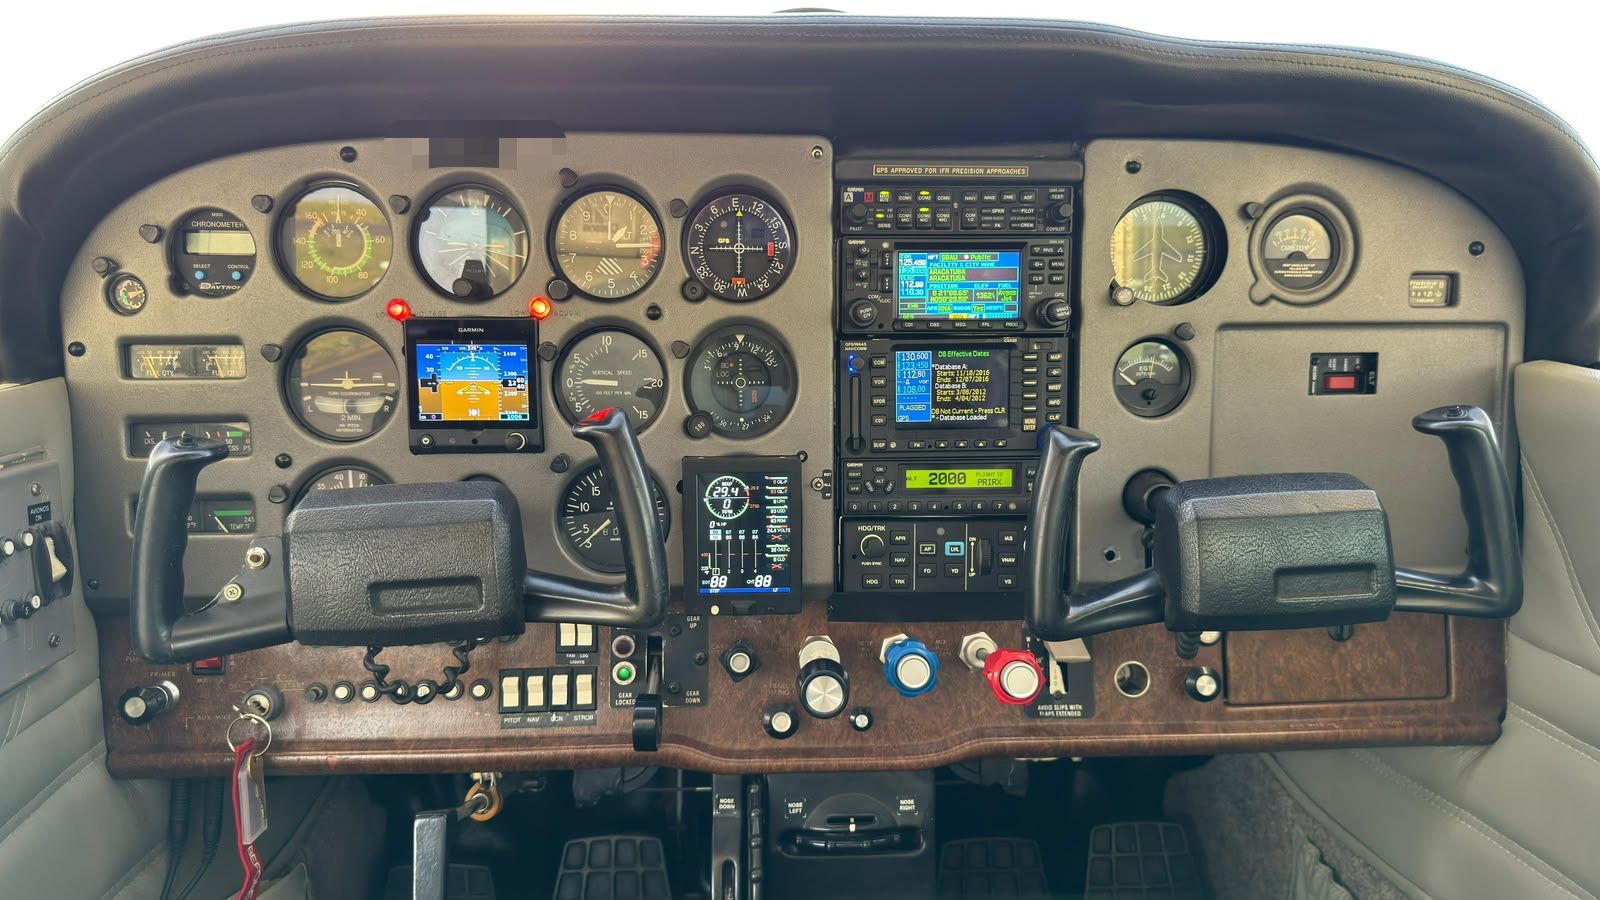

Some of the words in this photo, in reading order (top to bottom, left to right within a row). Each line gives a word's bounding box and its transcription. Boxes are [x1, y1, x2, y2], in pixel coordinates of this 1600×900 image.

[731, 197, 739, 207] E
[752, 201, 764, 213] 12
[356, 208, 366, 216] 40
[710, 205, 718, 214] 6
[305, 211, 318, 219] 160
[582, 211, 591, 221] 9
[695, 223, 703, 232] 3
[769, 217, 781, 229] 15
[640, 225, 648, 235] 2
[569, 231, 577, 240] 8
[778, 241, 788, 249] S
[690, 246, 700, 255] N
[569, 253, 576, 263] 7
[641, 256, 649, 266] 3
[301, 261, 314, 269] 120
[773, 262, 784, 274] 21
[585, 272, 593, 281] 6
[629, 271, 638, 280] 4
[697, 266, 709, 279] 33
[608, 279, 616, 289] 5
[713, 282, 726, 293] 30
[602, 335, 612, 346] 10
[574, 354, 580, 363] 5
[638, 349, 648, 358] 15
[901, 352, 928, 361] 130.600
[567, 378, 573, 388] 0
[651, 379, 663, 388] 20
[575, 403, 582, 412] 5
[639, 411, 648, 419] 15
[929, 472, 966, 486] 2000
[592, 486, 600, 496] 15
[713, 487, 739, 497] 29.4
[580, 502, 590, 512] 10
[723, 499, 731, 509] 0
[583, 524, 589, 533] 5
[710, 575, 727, 588] 88
[754, 574, 772, 587] 88
